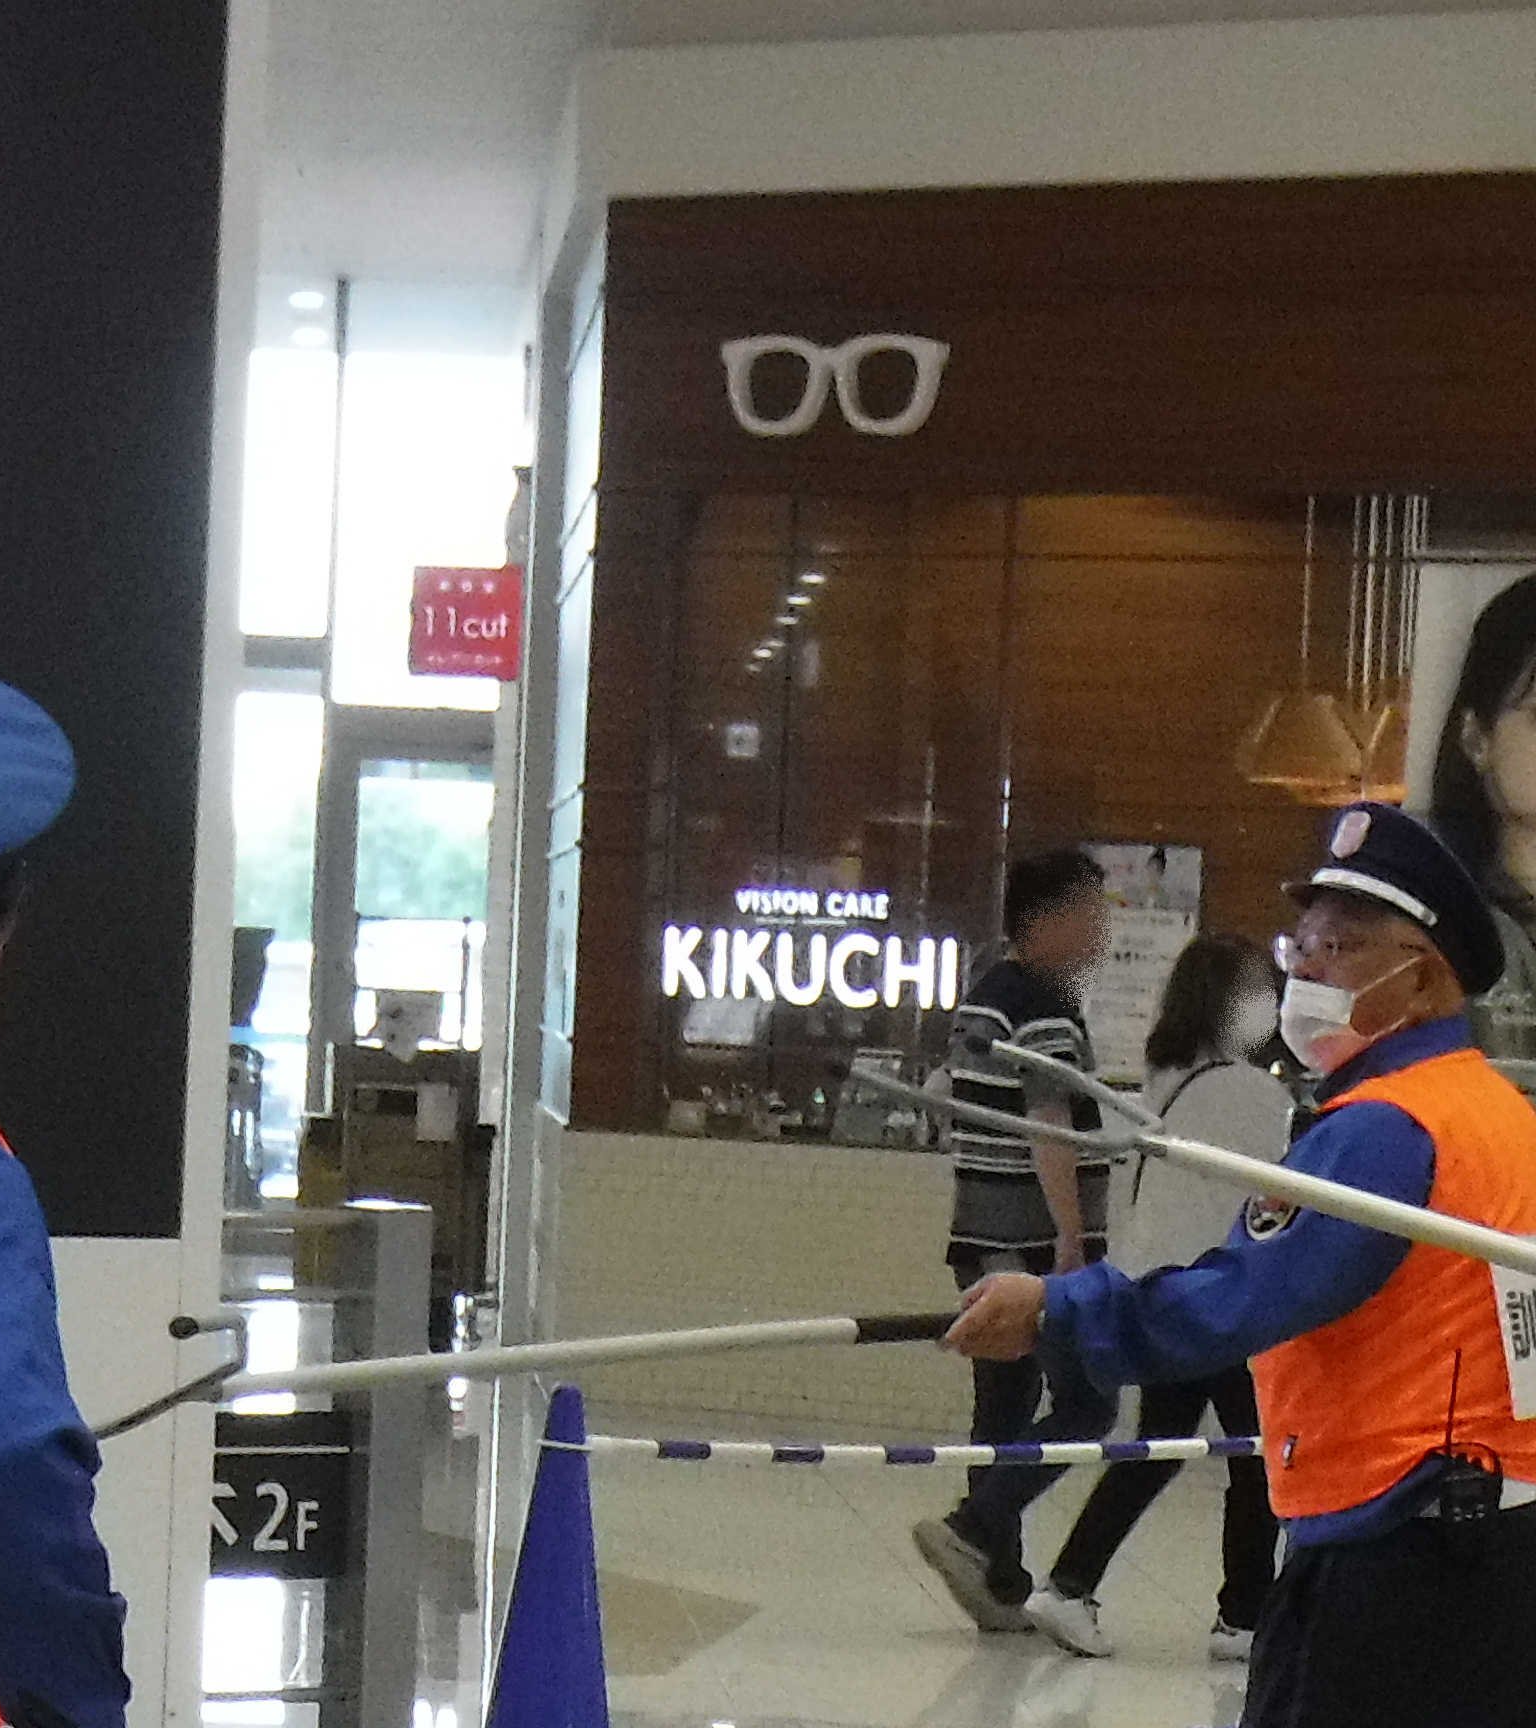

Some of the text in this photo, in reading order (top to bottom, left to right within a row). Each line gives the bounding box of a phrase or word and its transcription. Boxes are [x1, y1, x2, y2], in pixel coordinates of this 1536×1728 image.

[425, 606, 509, 639] 11cut
[735, 888, 891, 920] VISION CARE
[661, 922, 961, 1012] KIKUCHI
[252, 1481, 320, 1551] 2F
